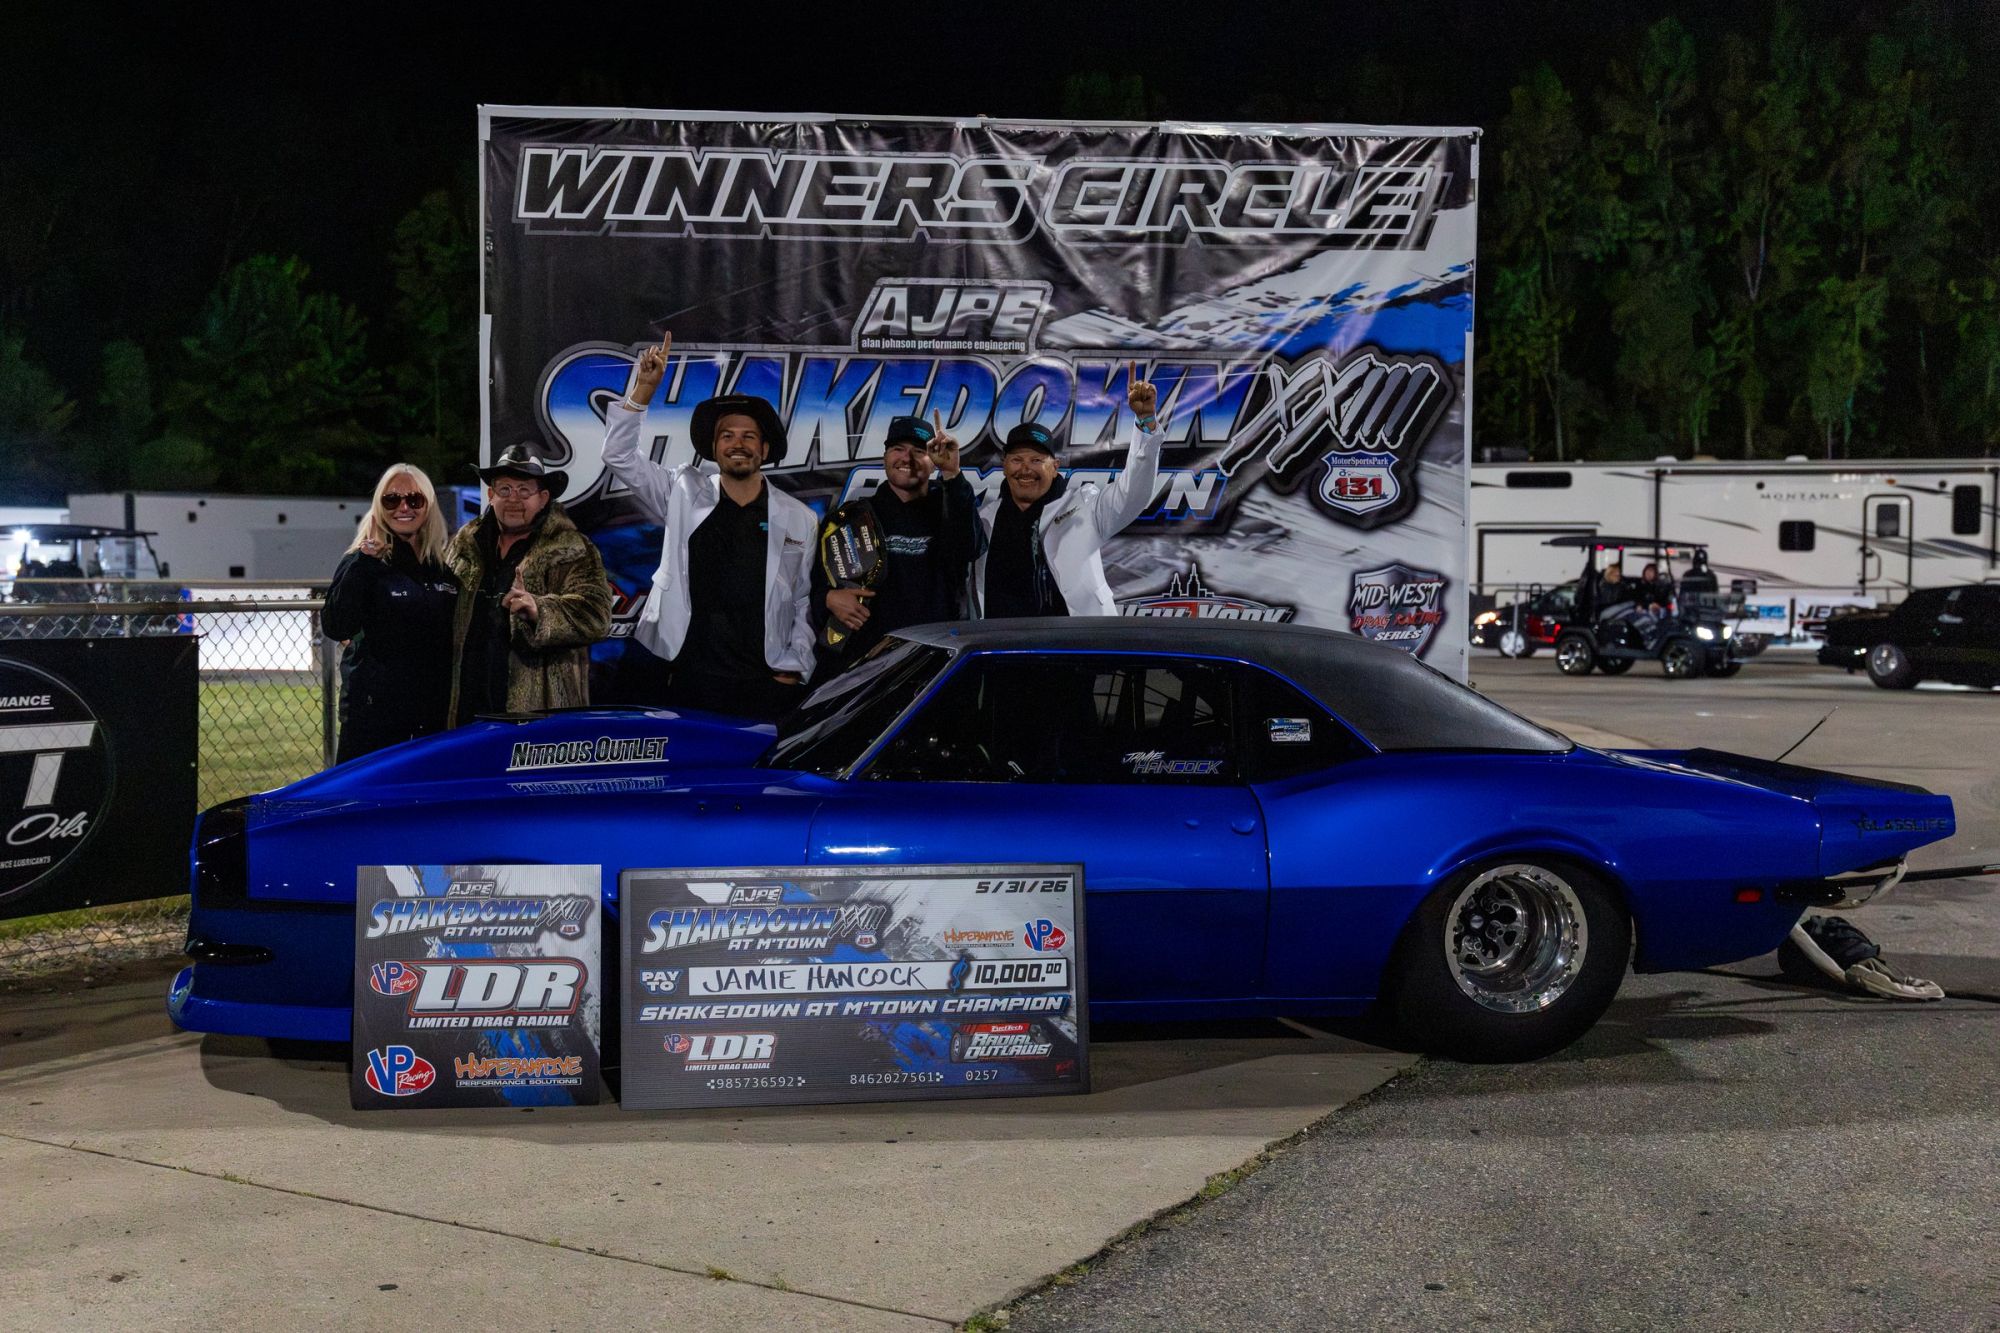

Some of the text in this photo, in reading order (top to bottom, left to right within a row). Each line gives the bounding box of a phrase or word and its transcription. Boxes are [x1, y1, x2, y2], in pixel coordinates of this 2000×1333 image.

[517, 147, 1433, 235] WINNERS CIRCLE
[875, 286, 1043, 338] AJPE
[861, 338, 1026, 352] alan johnson performance engineering
[1217, 352, 1441, 475] XXIII
[1331, 456, 1389, 467] MotorSportsPark
[1334, 477, 1383, 498] 131
[1761, 491, 1839, 500] MONTANA
[830, 535, 848, 580] CHAMPION
[1351, 582, 1444, 610] MID-WEST
[1353, 611, 1441, 629] DRAG RACING
[1374, 629, 1422, 641] SERIES
[1122, 750, 1166, 764] JAMIE
[1133, 759, 1223, 774] HANCOCK
[6, 811, 89, 846] Oils
[13, 856, 51, 868] LUBRICANTS
[449, 883, 493, 896] AJPE
[732, 888, 780, 902] AJPE
[976, 880, 1068, 893] 5/31/26
[366, 898, 546, 939] SHAKEDOWN
[444, 925, 535, 937] AT M'TOWN
[642, 906, 839, 953] SHAKEDOWN
[1024, 918, 1054, 951] VP
[728, 937, 828, 950] AT M'TOWN
[372, 961, 404, 994] VP
[641, 970, 679, 981] PAY
[703, 965, 928, 993] JAMIE HANCOCK
[413, 964, 580, 1011] LDR
[647, 981, 676, 991] TO
[639, 996, 1063, 1021] SHAKEDOWN AT M'TOWN CHAMPION
[408, 1015, 570, 1028] LIMITED DRAG RADIAL
[688, 1034, 775, 1060] LDR
[971, 1033, 1033, 1046] RADIAL
[964, 1043, 1052, 1060] OUTLAWS
[367, 1045, 415, 1096] VP
[684, 1062, 770, 1072] LIMITED DRAG RADIAL
[399, 1069, 435, 1088] Racing
[717, 1070, 998, 1088] 985736592 8462027561 0257
